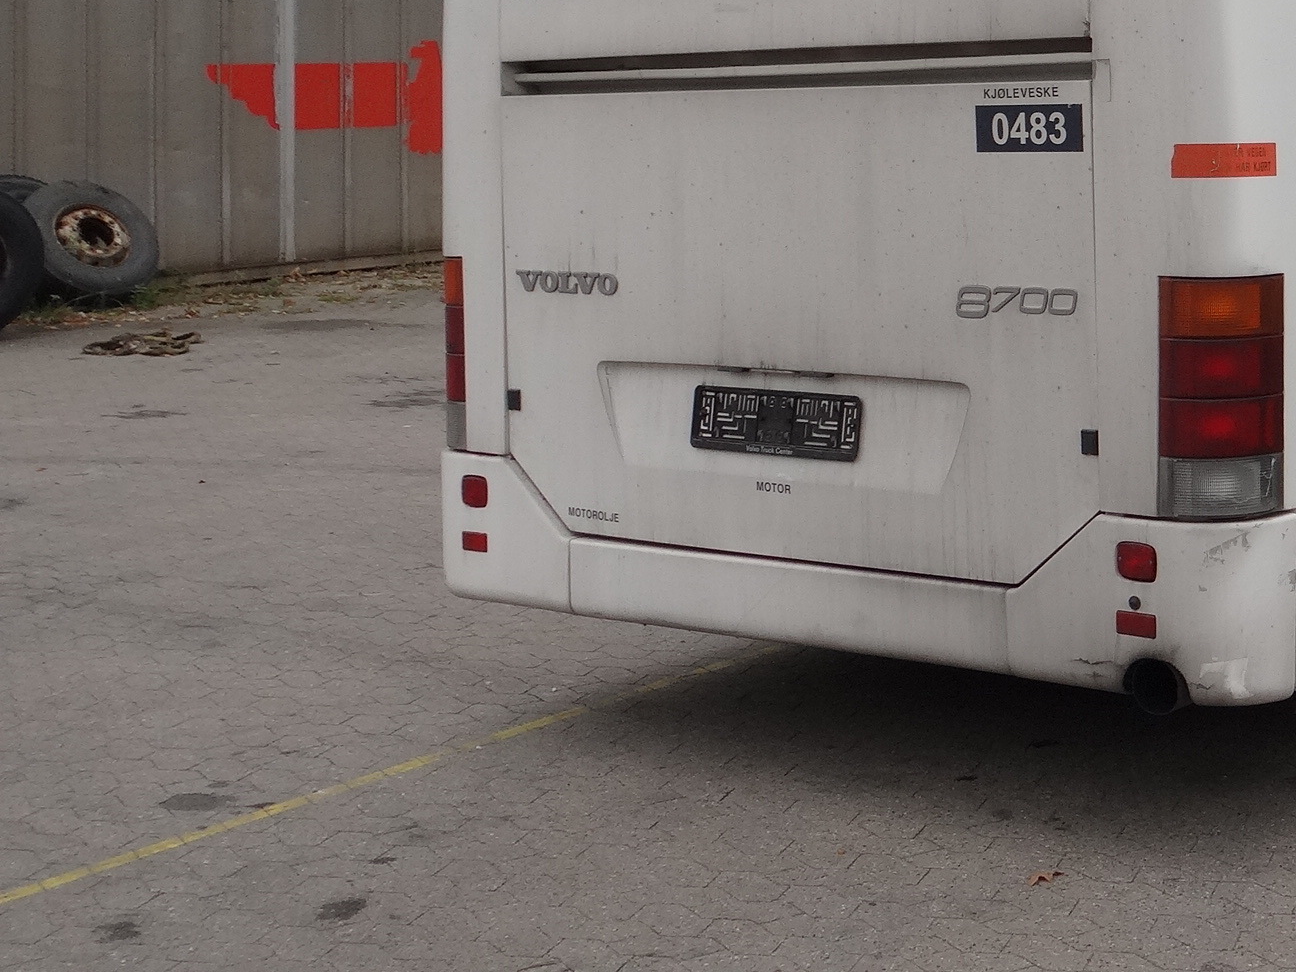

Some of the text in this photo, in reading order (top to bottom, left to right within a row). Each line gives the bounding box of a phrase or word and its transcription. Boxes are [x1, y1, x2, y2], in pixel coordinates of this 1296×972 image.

[983, 86, 1059, 99] KJØLEVESKE
[991, 111, 1067, 146] 0483
[516, 270, 618, 296] VOLVO
[956, 286, 1078, 318] 8700
[756, 481, 791, 494] MOTOR
[568, 506, 619, 523] MOTOROLJE
